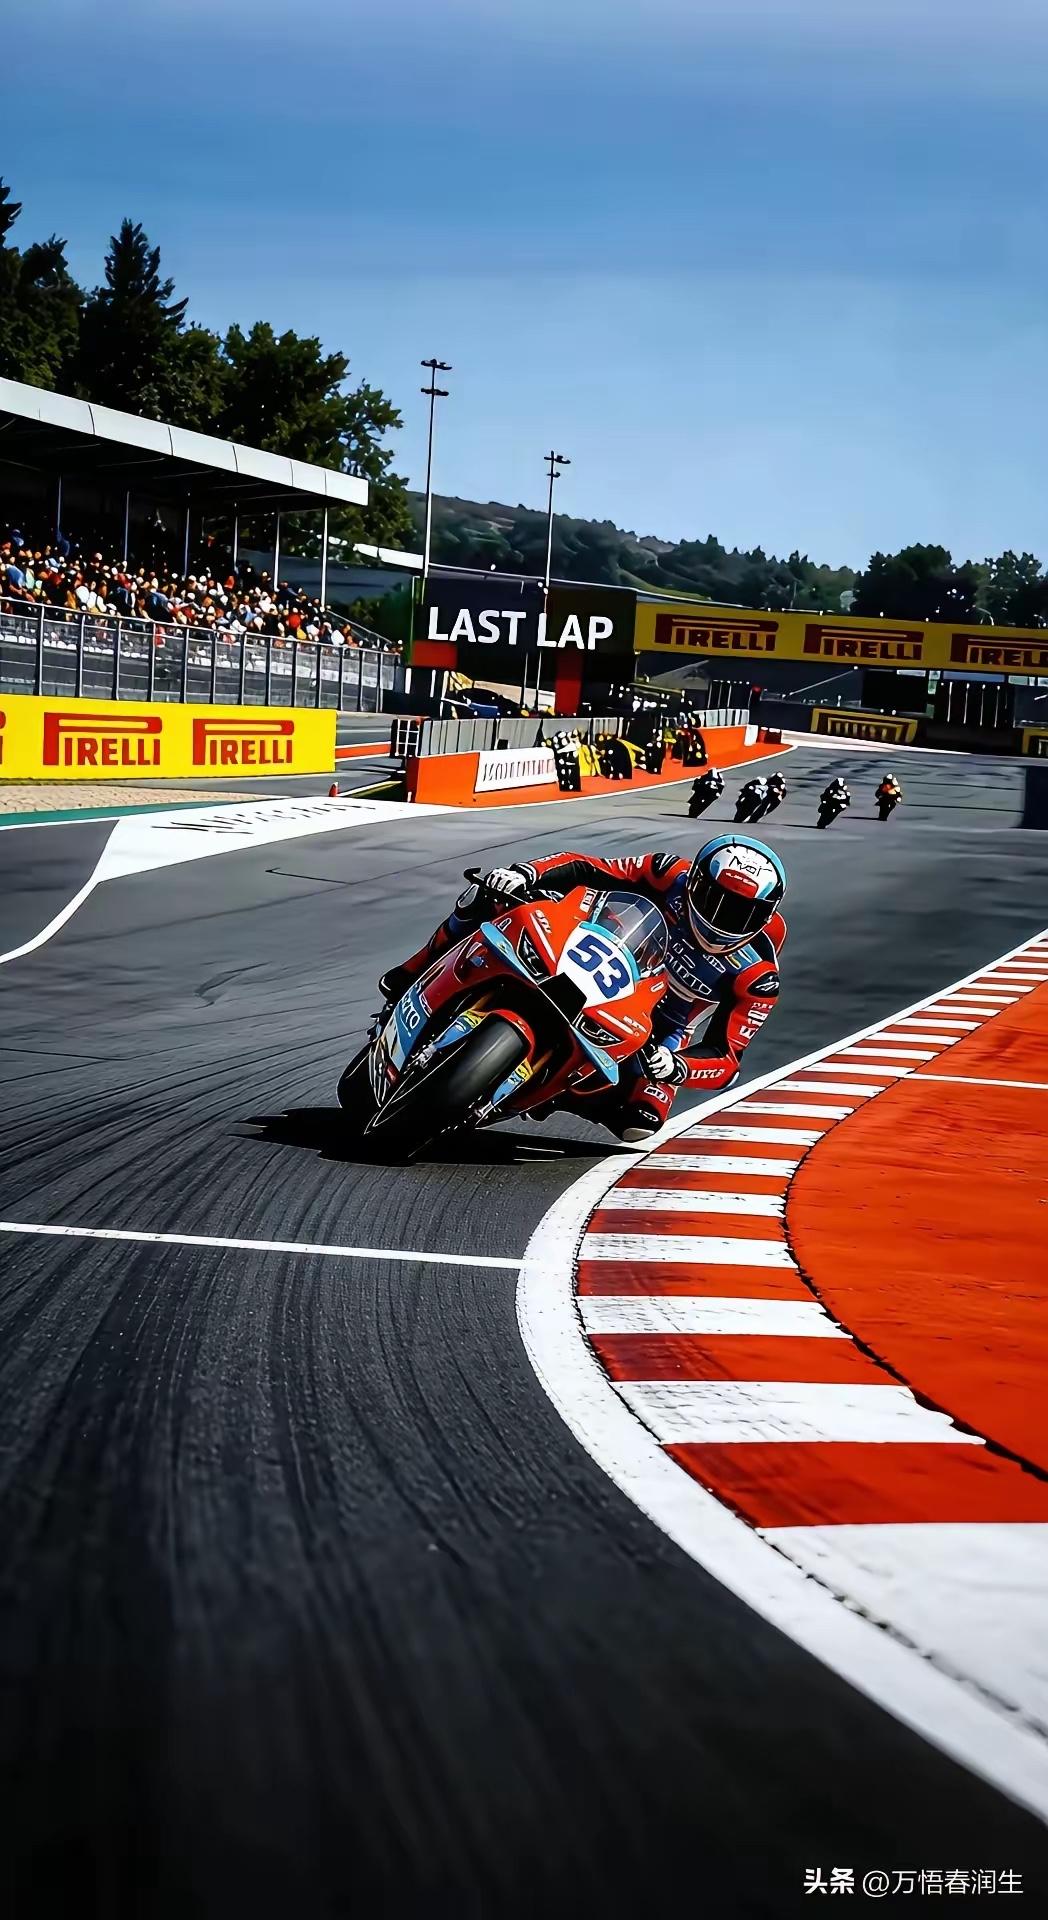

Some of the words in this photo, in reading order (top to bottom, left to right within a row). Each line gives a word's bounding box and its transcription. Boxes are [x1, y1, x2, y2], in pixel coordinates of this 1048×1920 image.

[428, 606, 526, 645] LAST
[536, 612, 614, 650] LAP
[655, 613, 779, 652] PIRELLI
[803, 623, 925, 661] PIRELLI
[43, 712, 163, 766] PIRELLI
[192, 718, 295, 765] PIRELLI
[566, 934, 631, 999] 53
